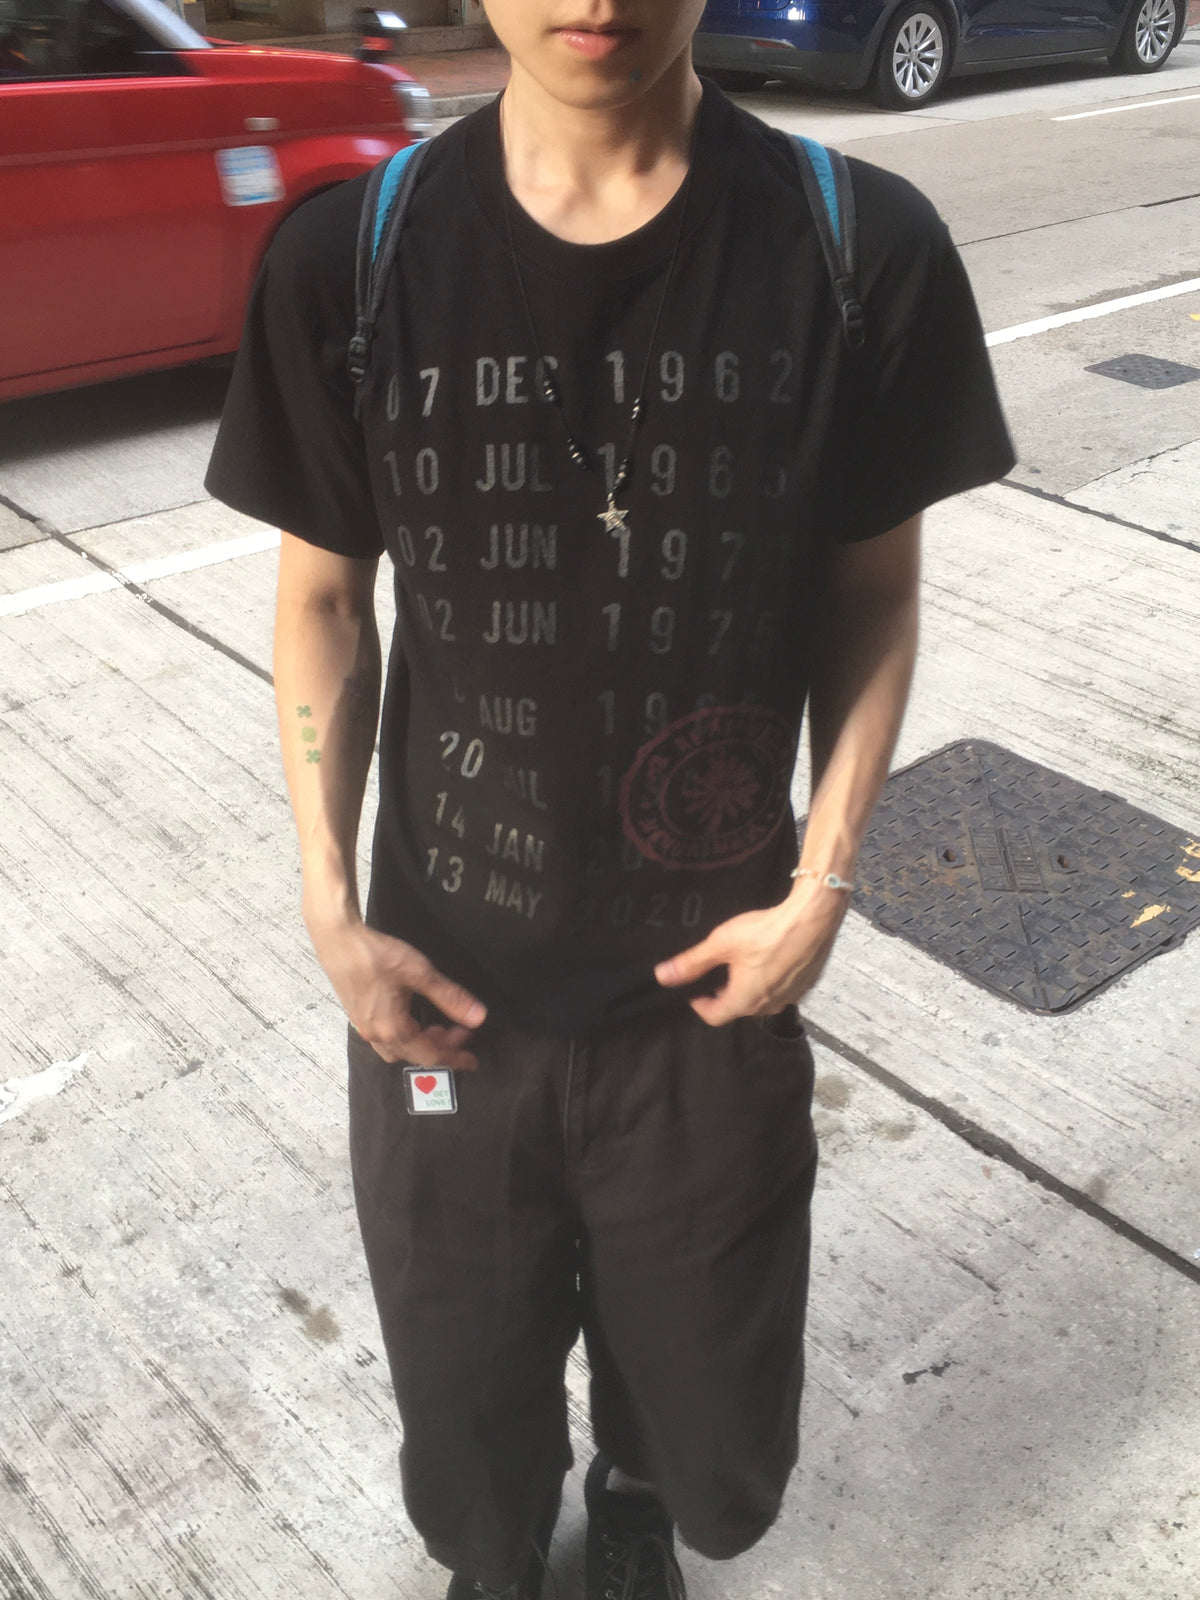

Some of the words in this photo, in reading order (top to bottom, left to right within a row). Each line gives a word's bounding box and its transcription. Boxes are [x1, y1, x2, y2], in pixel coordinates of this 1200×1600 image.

[385, 366, 440, 421] 07
[475, 355, 558, 406] DEC
[382, 447, 439, 496] 10
[475, 443, 553, 492] JUL
[397, 525, 448, 572] 02
[479, 523, 559, 570] JUN
[482, 600, 557, 645] JUN
[478, 694, 538, 737] AUG
[436, 790, 465, 840] 14
[485, 822, 546, 873] JAN
[425, 846, 465, 894] 13
[484, 870, 544, 920] MAY
